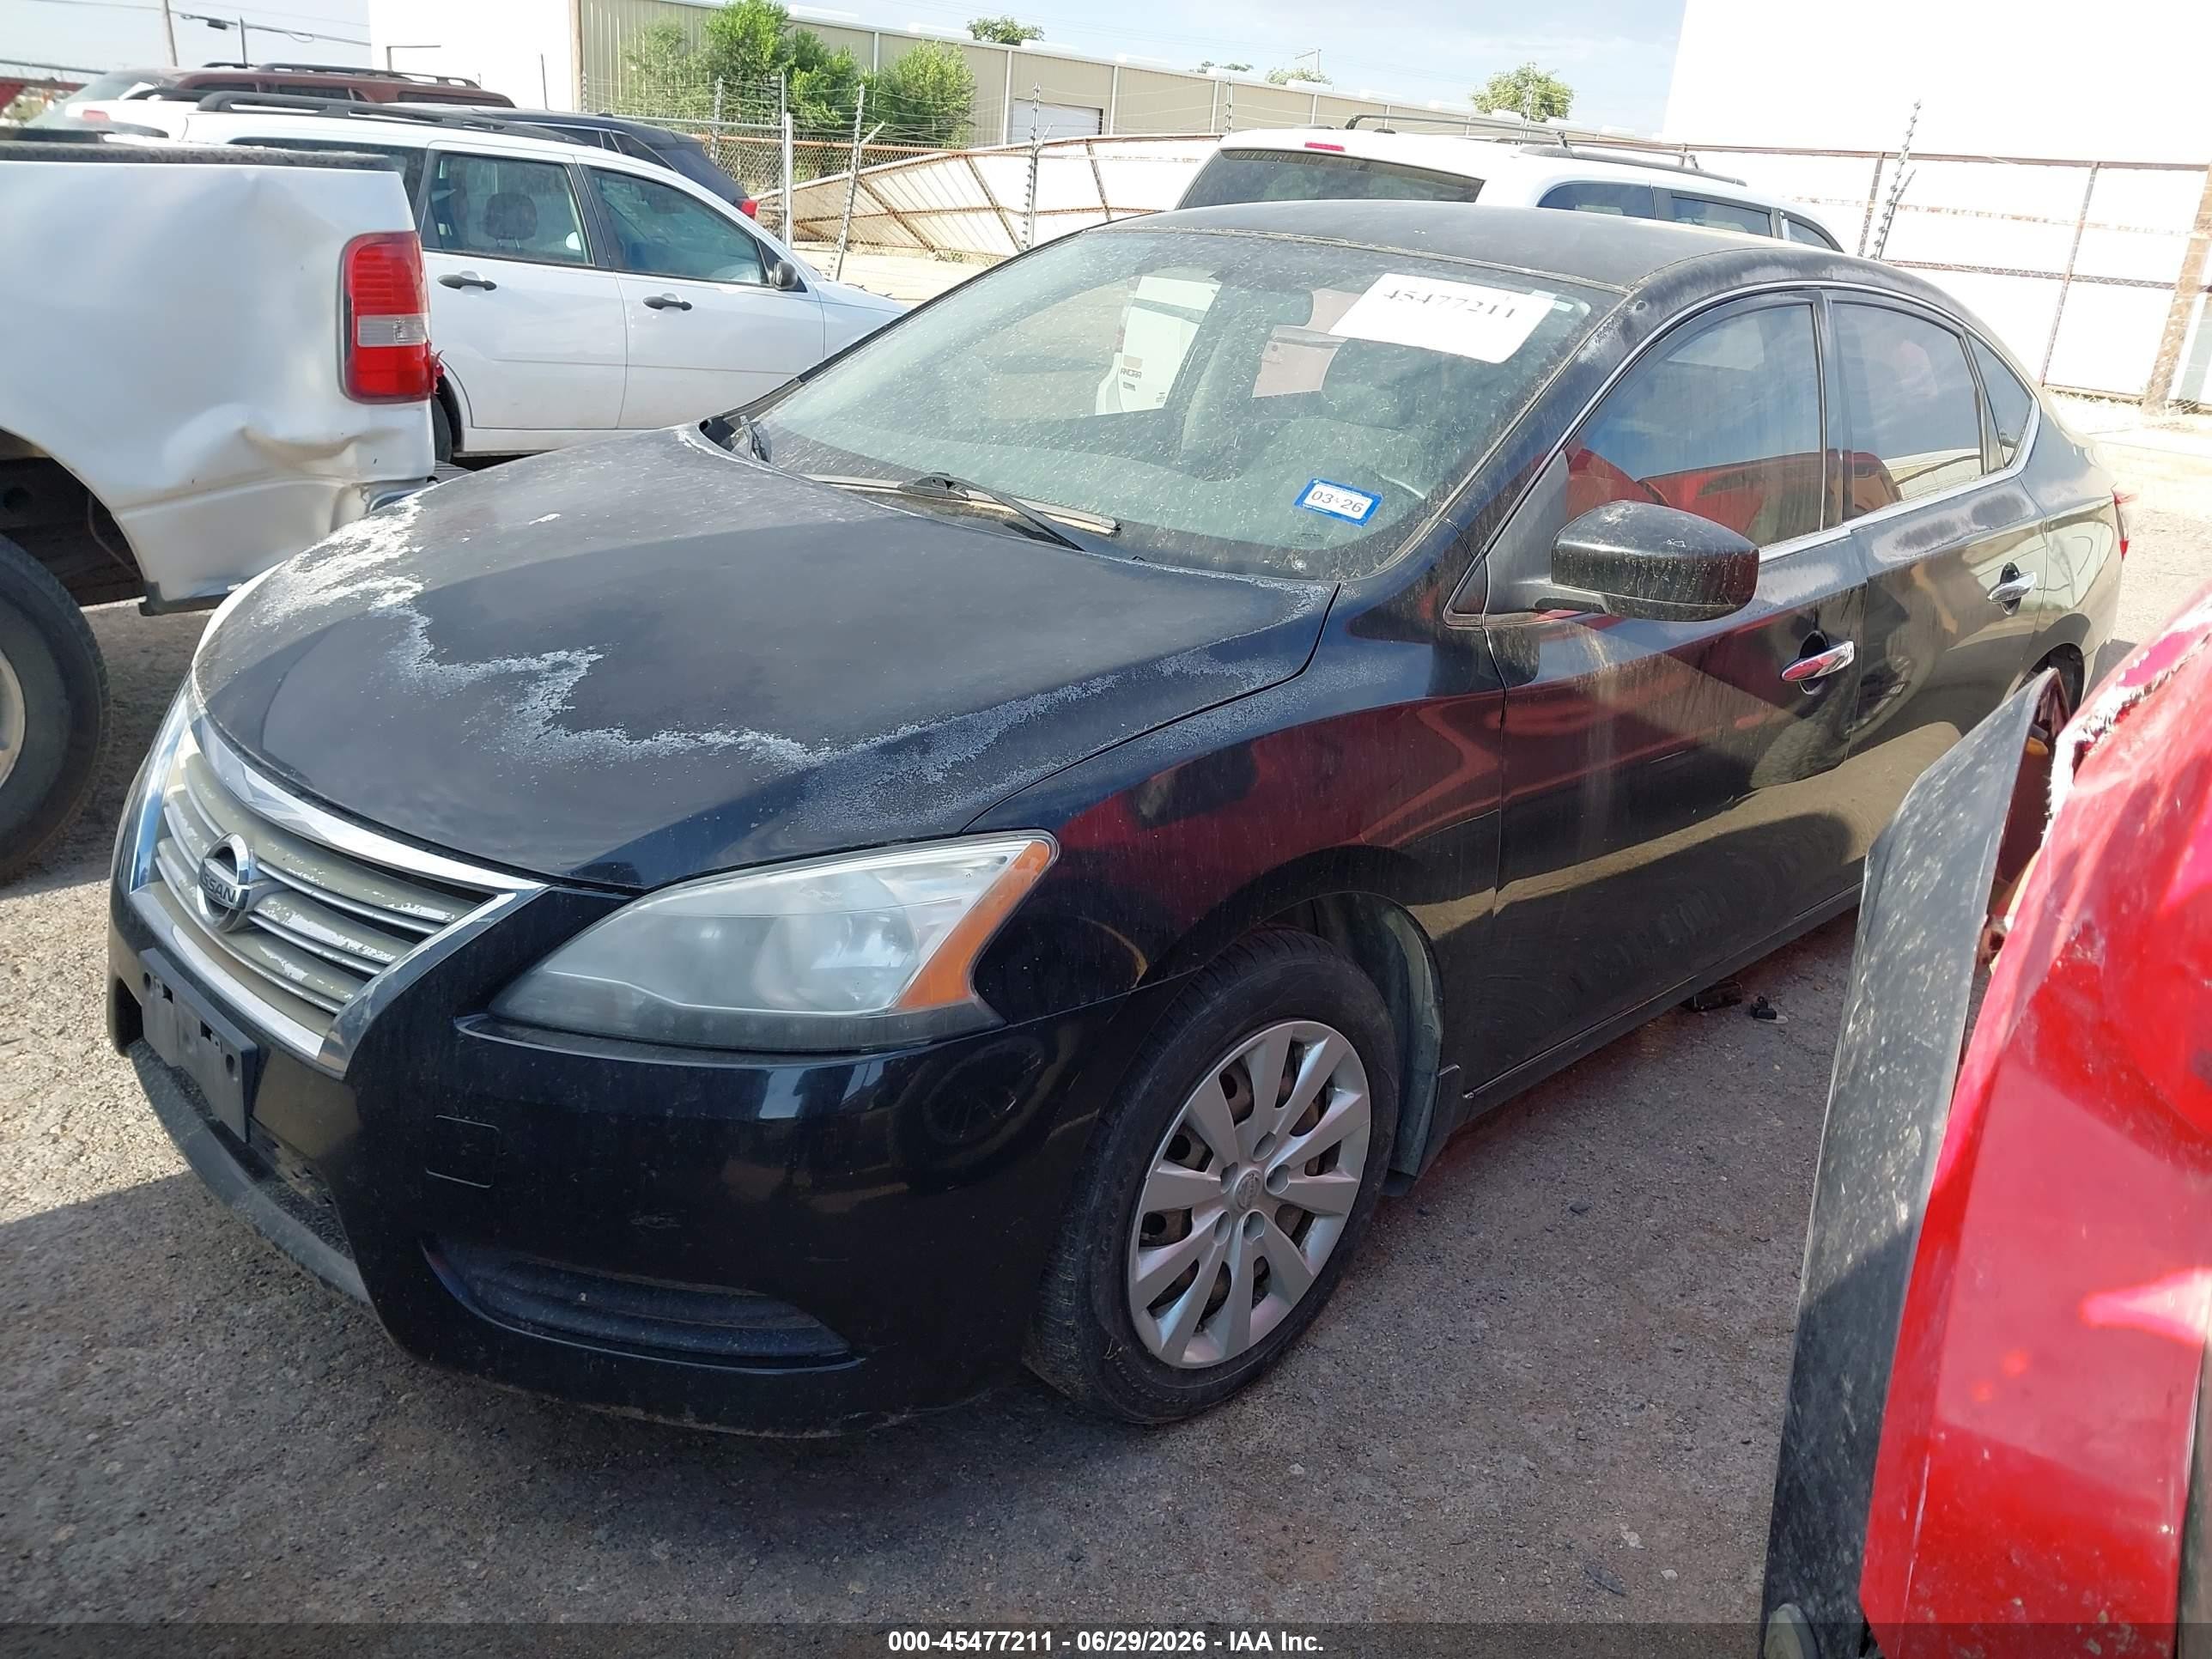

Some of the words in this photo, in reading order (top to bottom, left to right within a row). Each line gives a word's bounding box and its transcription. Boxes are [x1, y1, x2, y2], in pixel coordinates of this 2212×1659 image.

[1383, 289, 1516, 319] 45477211
[1311, 490, 1334, 504] 03
[1340, 499, 1364, 513] 26
